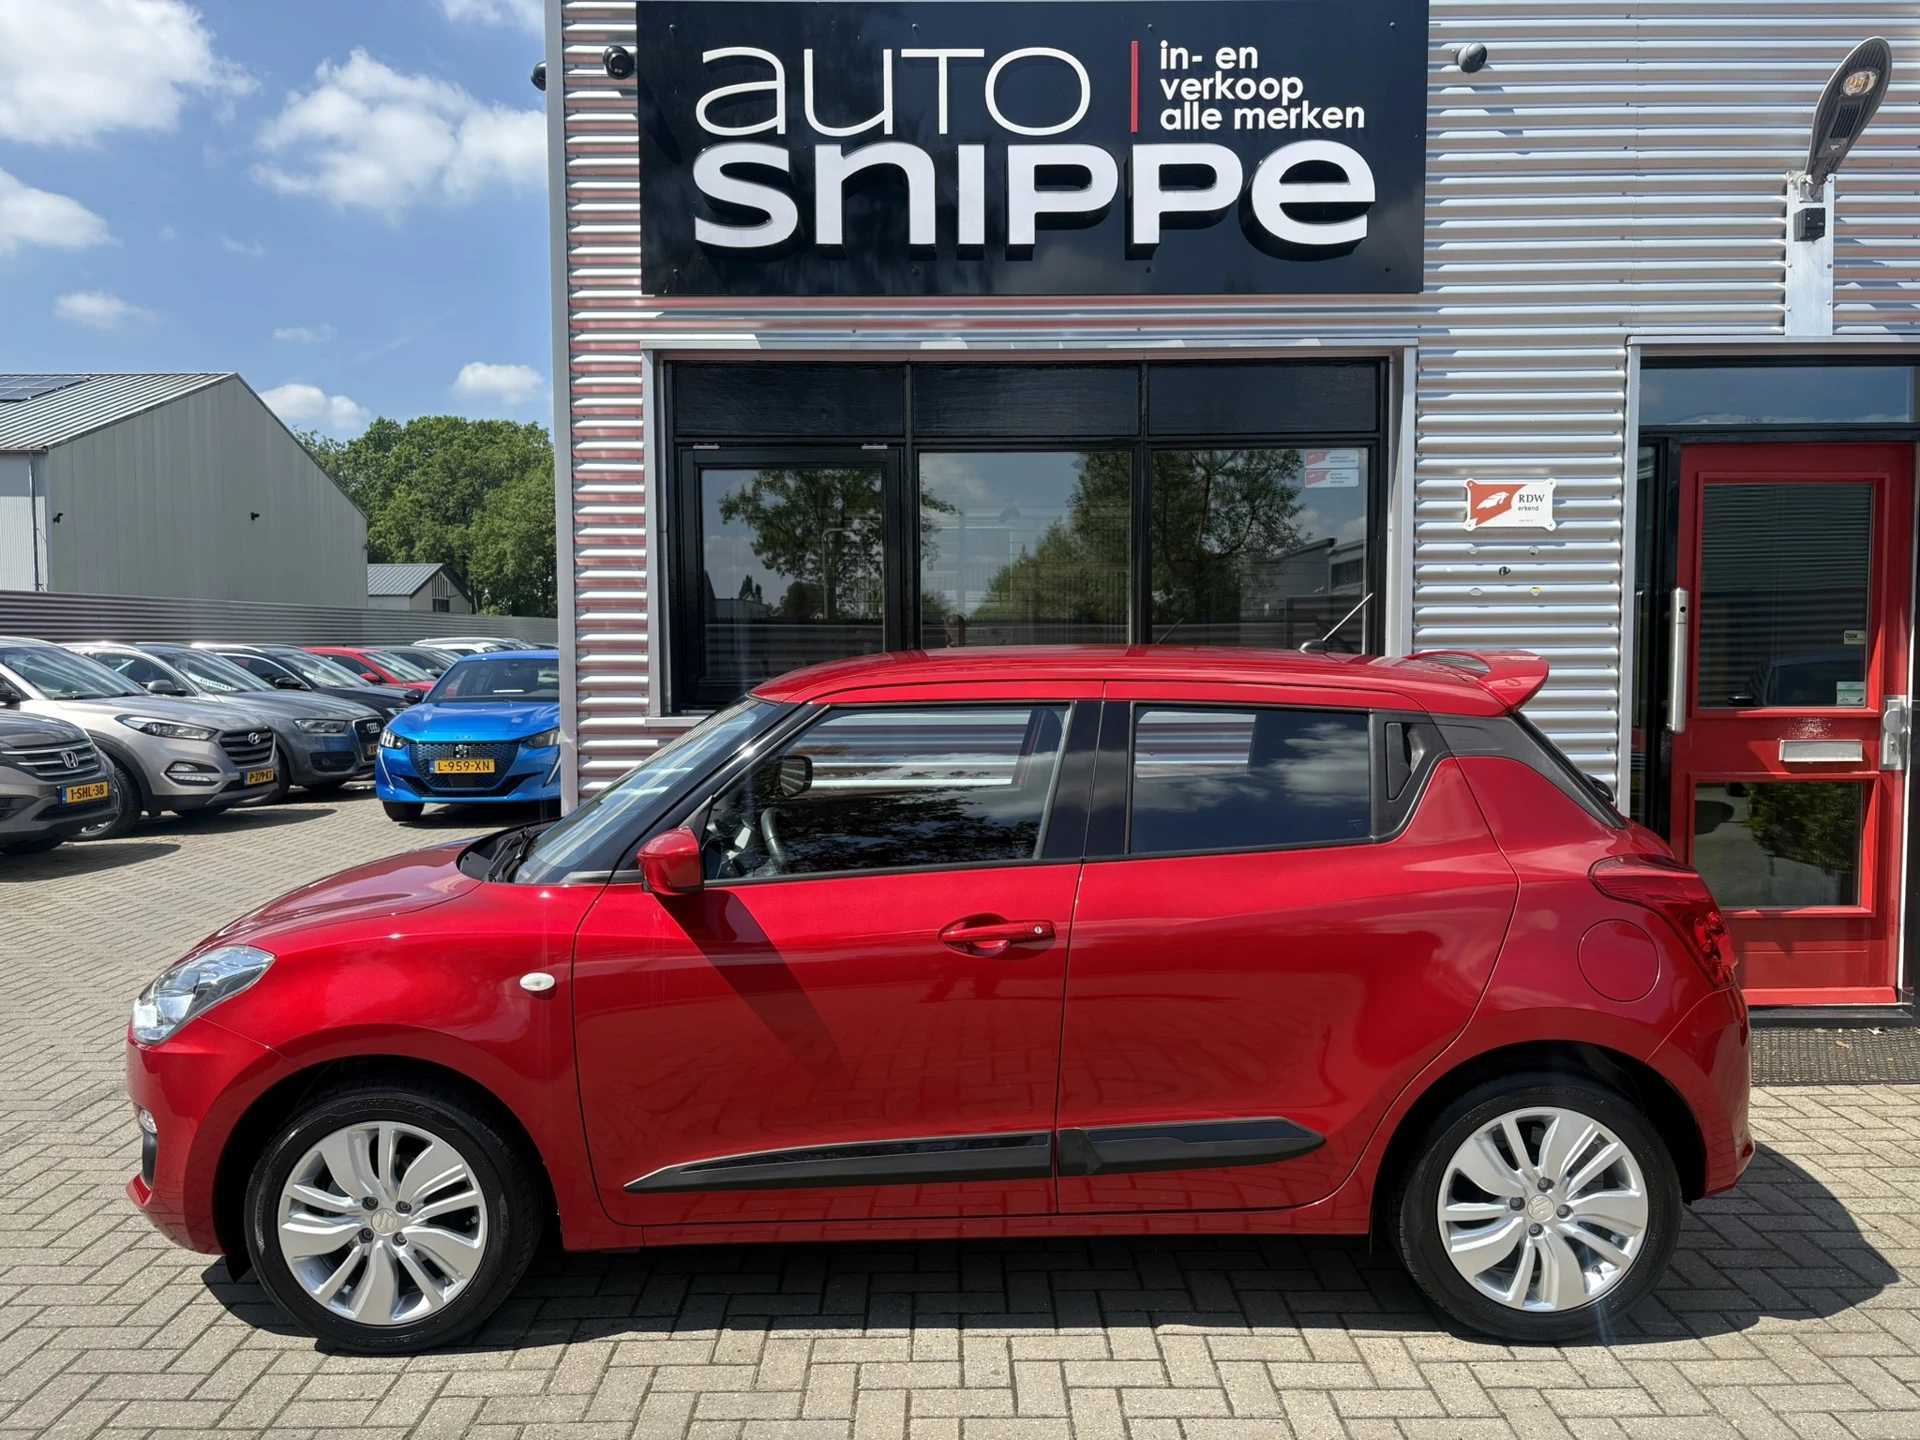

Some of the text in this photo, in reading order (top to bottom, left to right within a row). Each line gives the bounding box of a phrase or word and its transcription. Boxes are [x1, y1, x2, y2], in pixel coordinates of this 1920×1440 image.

[1160, 40, 1258, 70] in- en
[1160, 70, 1304, 106] verkoop
[1160, 100, 1365, 131] alle merken
[1517, 504, 1540, 512] erkend
[1518, 494, 1546, 504] RDW
[437, 760, 490, 773] L-959-XN
[70, 783, 105, 801] 1-SHL-38
